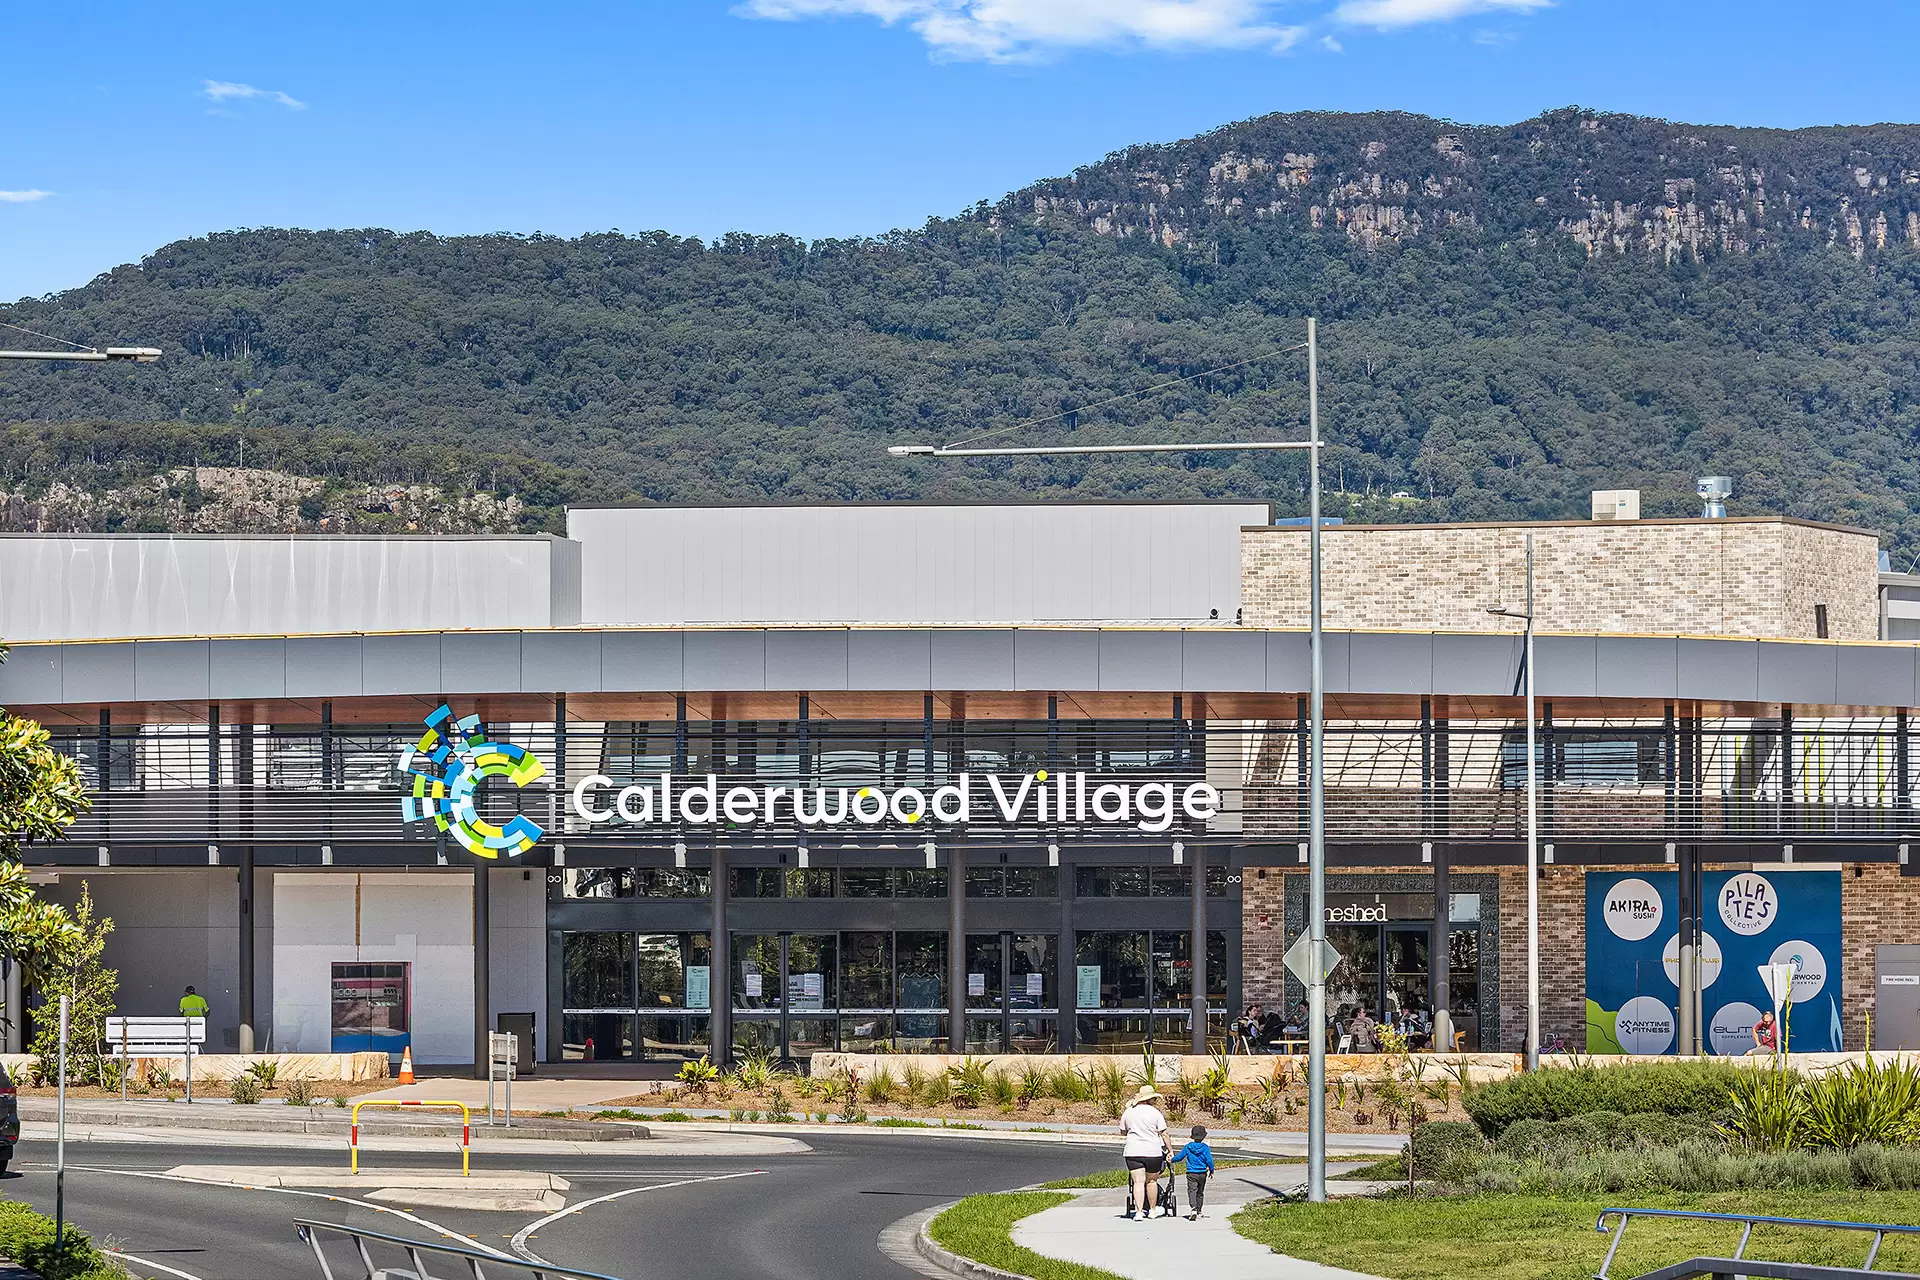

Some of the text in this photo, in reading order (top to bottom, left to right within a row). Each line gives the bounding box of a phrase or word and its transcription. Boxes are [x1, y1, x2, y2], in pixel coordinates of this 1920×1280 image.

[573, 770, 1219, 832] Calderwood Village
[1609, 899, 1651, 912] AKIRA
[1632, 912, 1655, 920] SUSHI
[1724, 909, 1762, 928] COLLECTIVE
